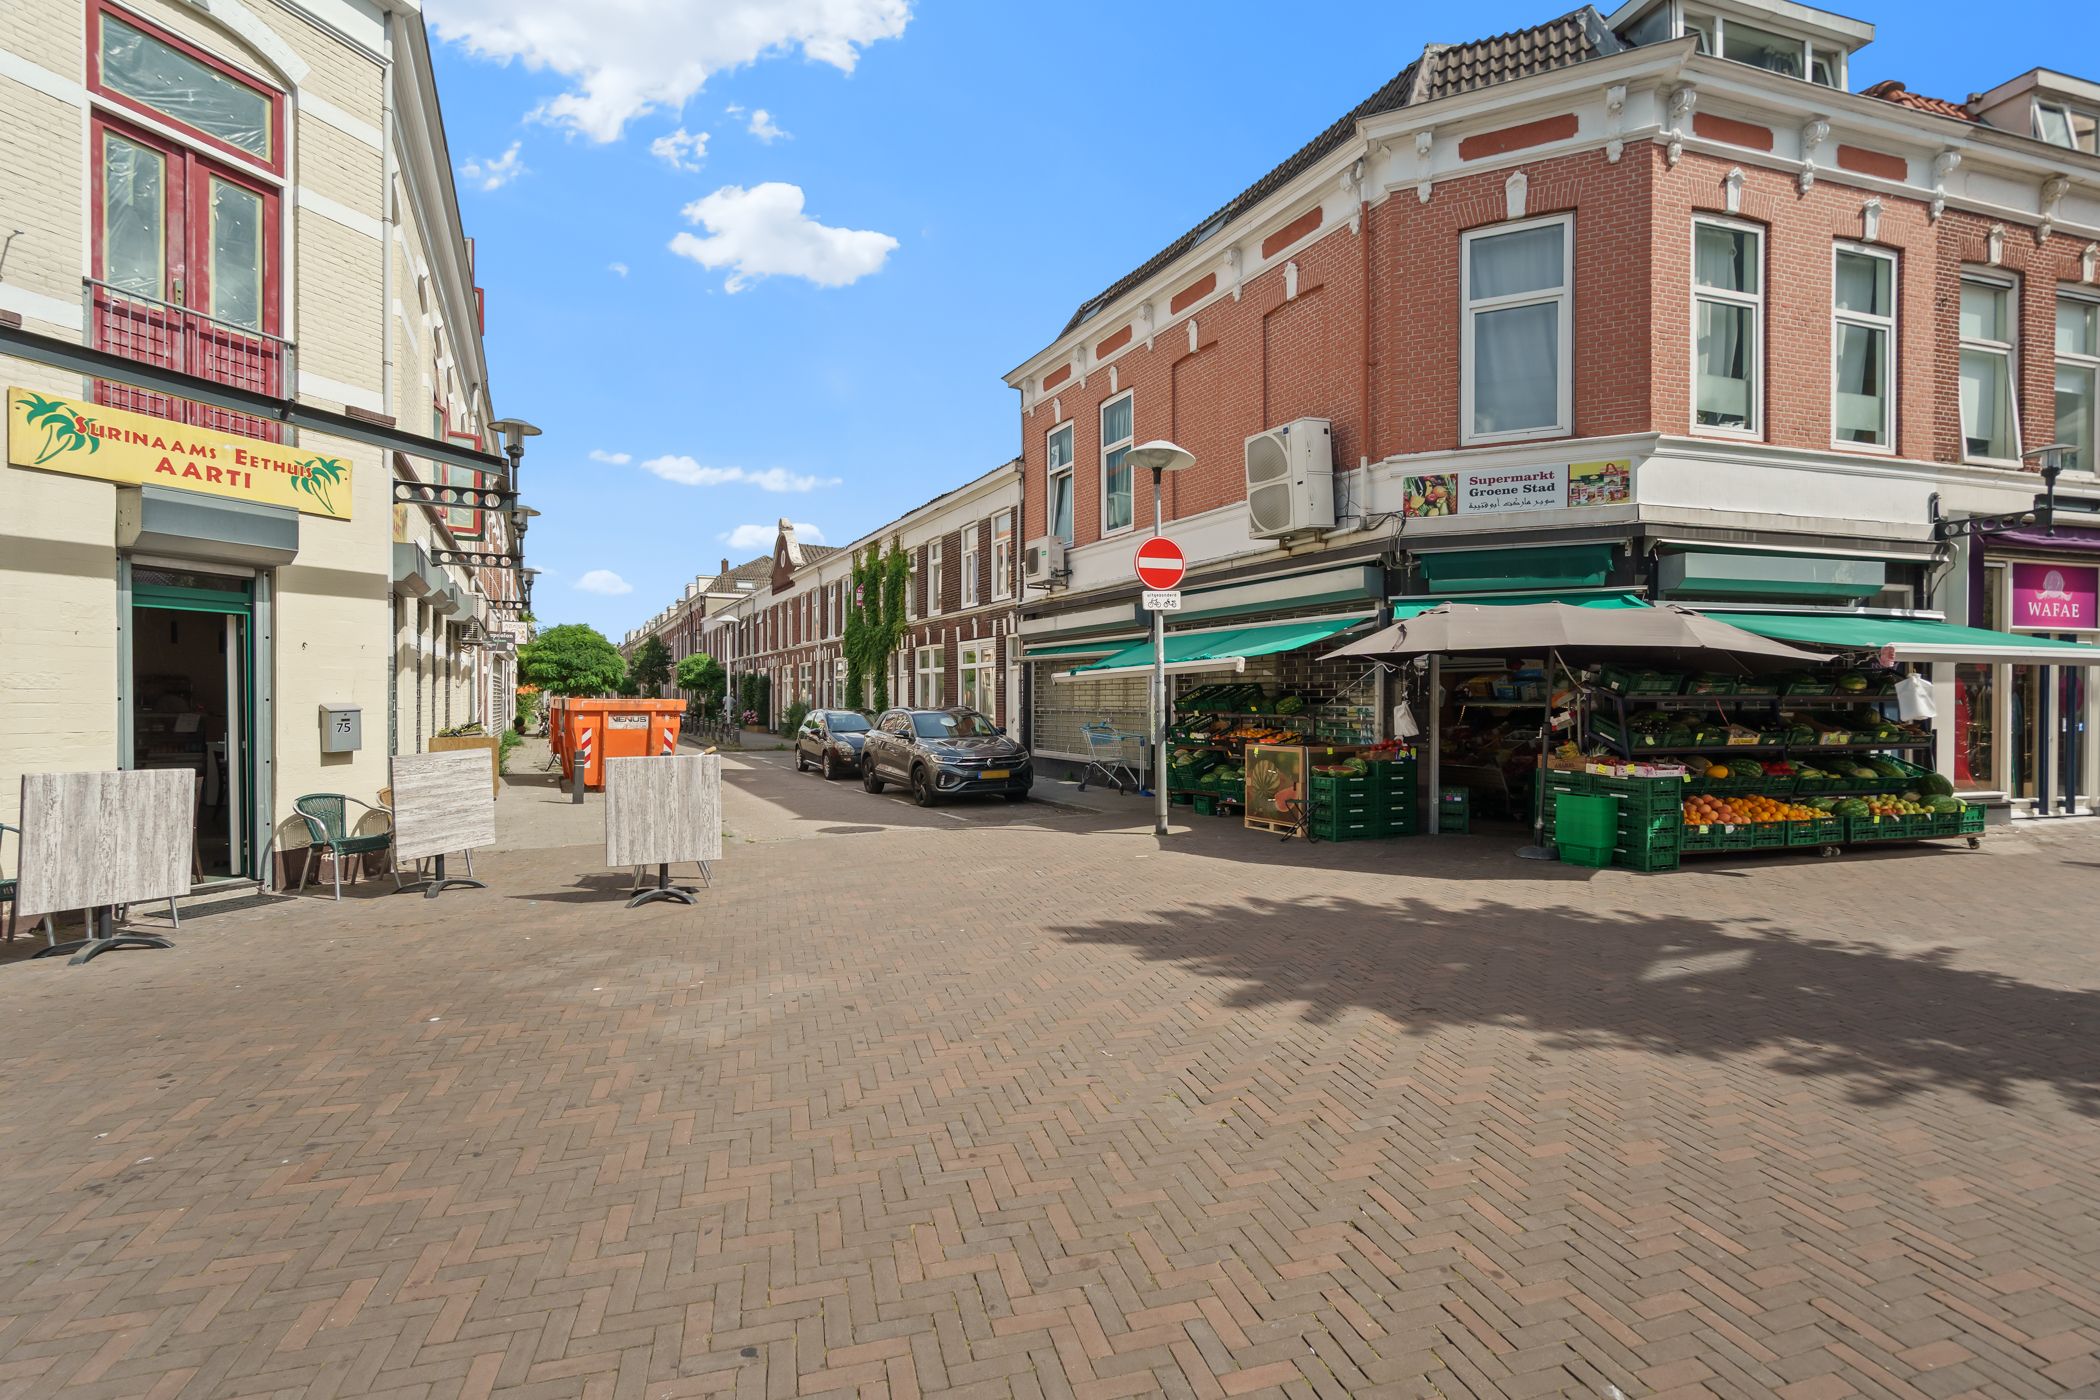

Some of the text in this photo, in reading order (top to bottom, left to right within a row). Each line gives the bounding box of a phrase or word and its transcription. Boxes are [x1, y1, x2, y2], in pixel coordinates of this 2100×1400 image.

[155, 457, 252, 489] AARTI
[1469, 471, 1555, 487] Supermarkt
[1469, 483, 1555, 497] Groene Stad
[2028, 602, 2080, 618] WAFAE
[336, 723, 351, 733] 75
